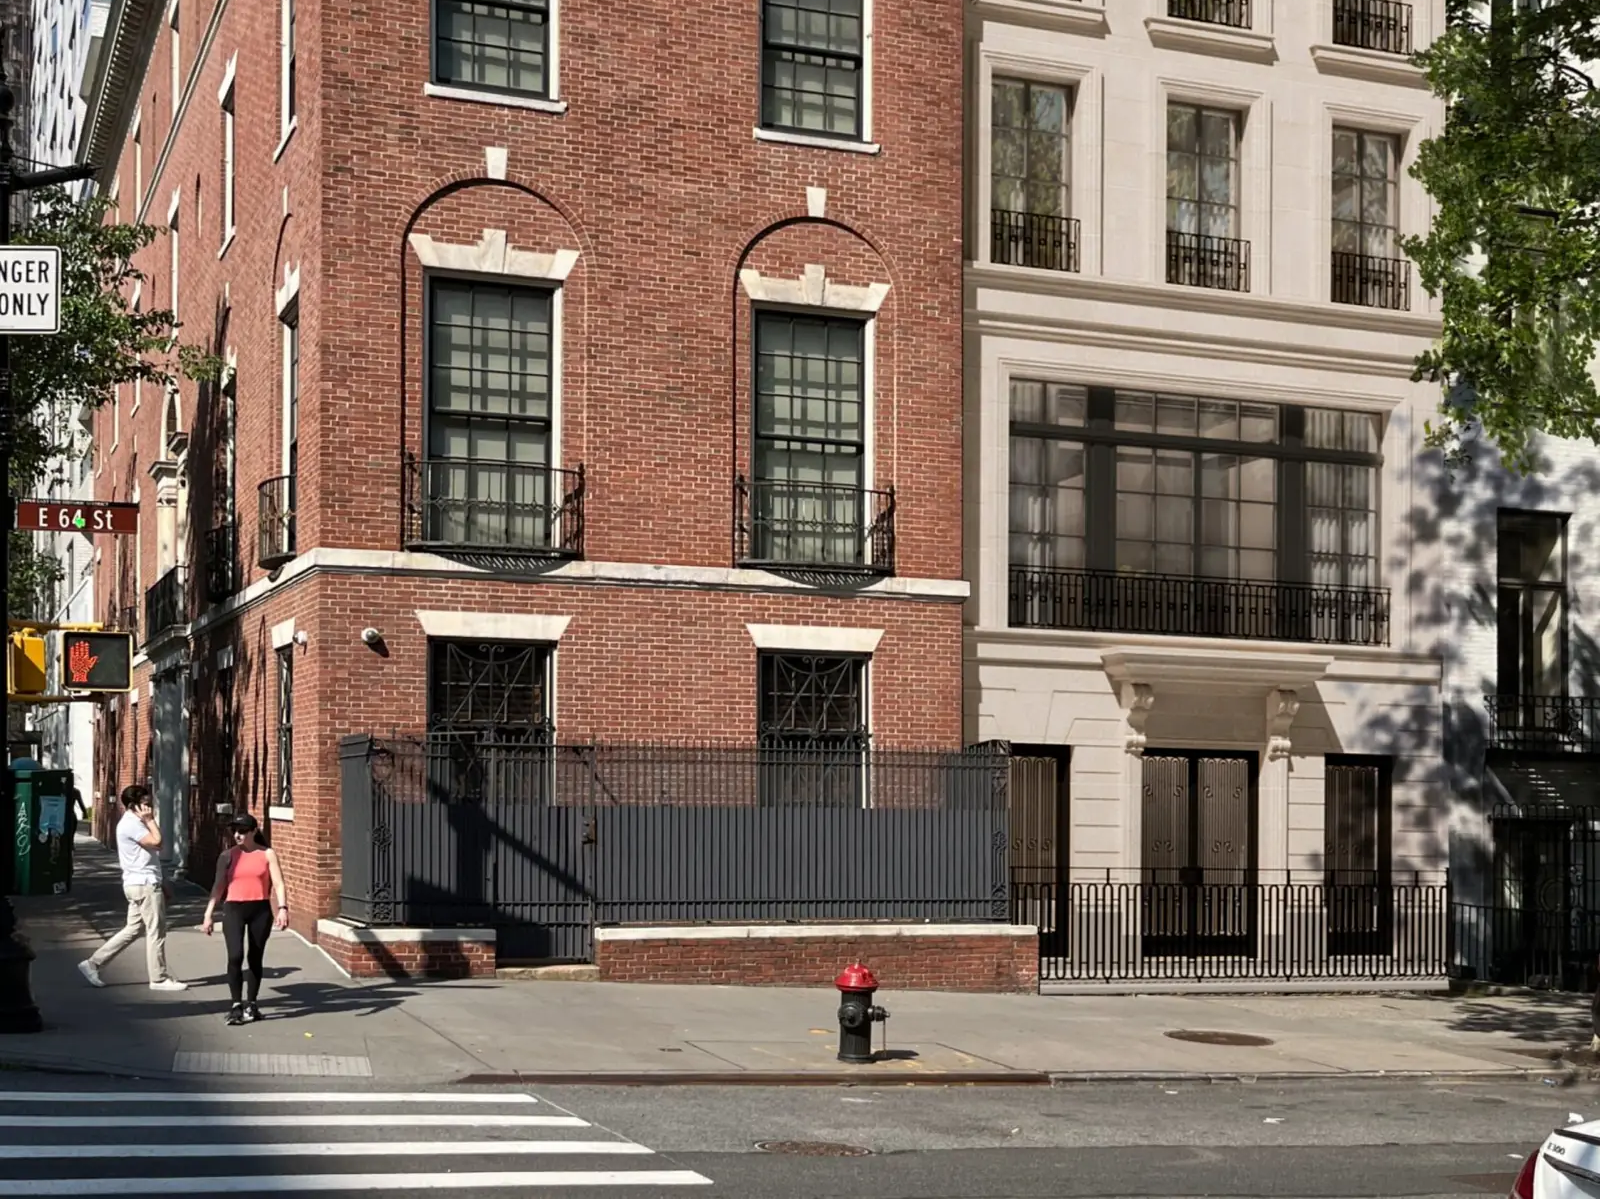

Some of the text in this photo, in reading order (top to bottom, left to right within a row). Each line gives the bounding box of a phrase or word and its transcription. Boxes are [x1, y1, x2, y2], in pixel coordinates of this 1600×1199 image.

[0, 293, 50, 316] ONLY
[39, 507, 48, 527] E
[93, 509, 113, 530] St
